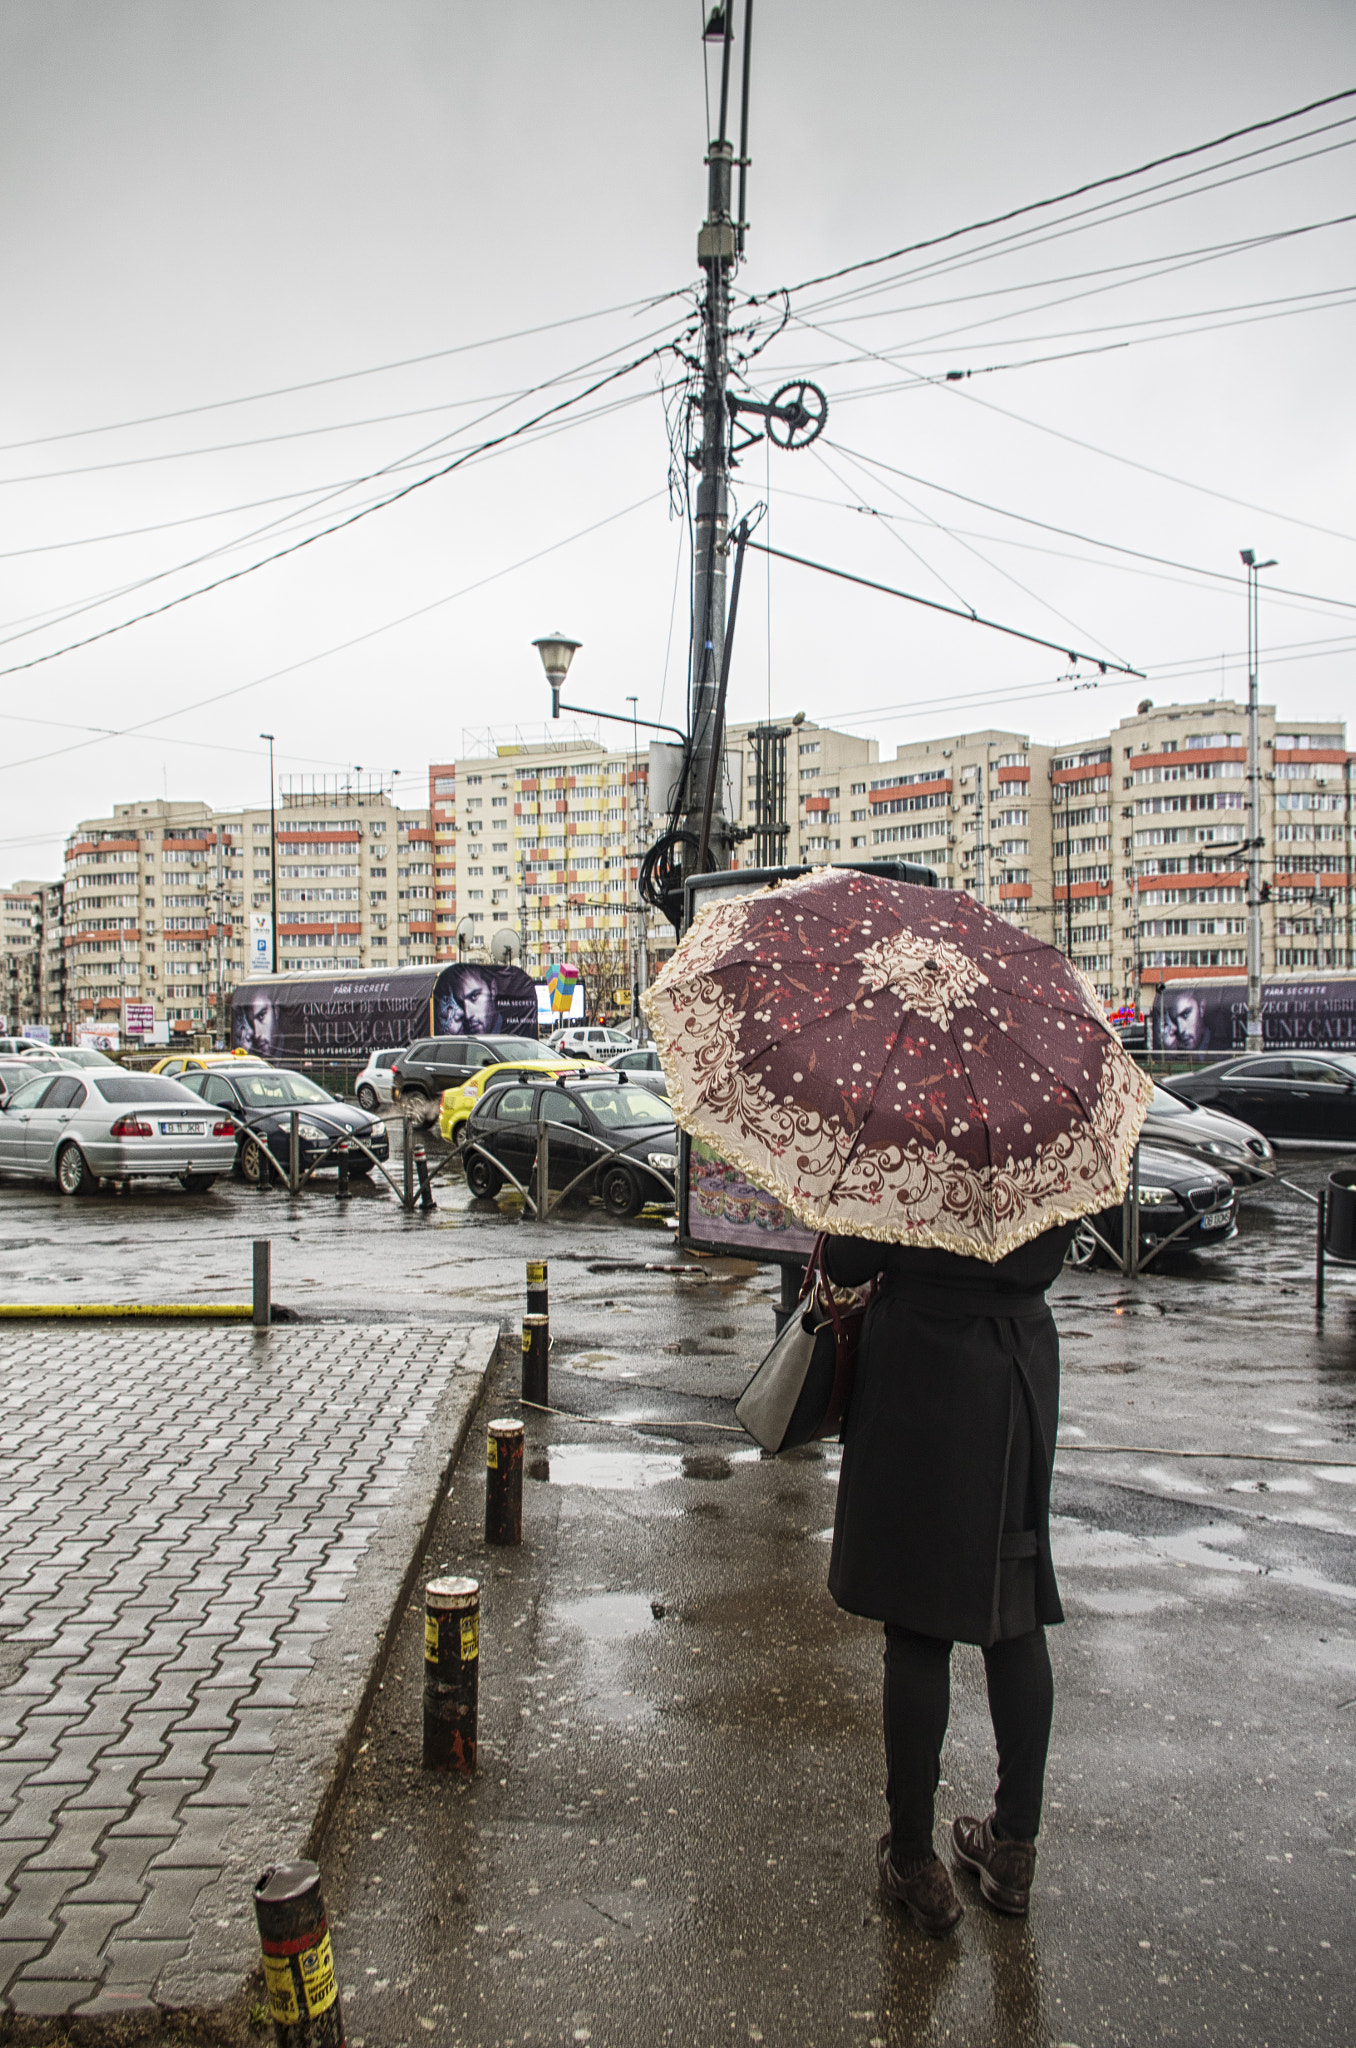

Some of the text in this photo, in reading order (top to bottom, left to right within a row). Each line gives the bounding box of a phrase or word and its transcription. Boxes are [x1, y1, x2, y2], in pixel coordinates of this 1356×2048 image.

[333, 982, 390, 994] FĂRĂ SECRETE
[1264, 985, 1327, 996] FĂRĂ SECRETE
[303, 997, 417, 1015] CINCIZECI DE UMBRE
[1231, 1001, 1288, 1014] CINZECI
[1293, 1000, 1310, 1013] DE
[303, 1015, 418, 1044] ÎNTUNECATE
[1231, 1014, 1356, 1039] ÎNUNECATE
[304, 1047, 315, 1055] DIN
[327, 1047, 362, 1055] FEBRUARIE
